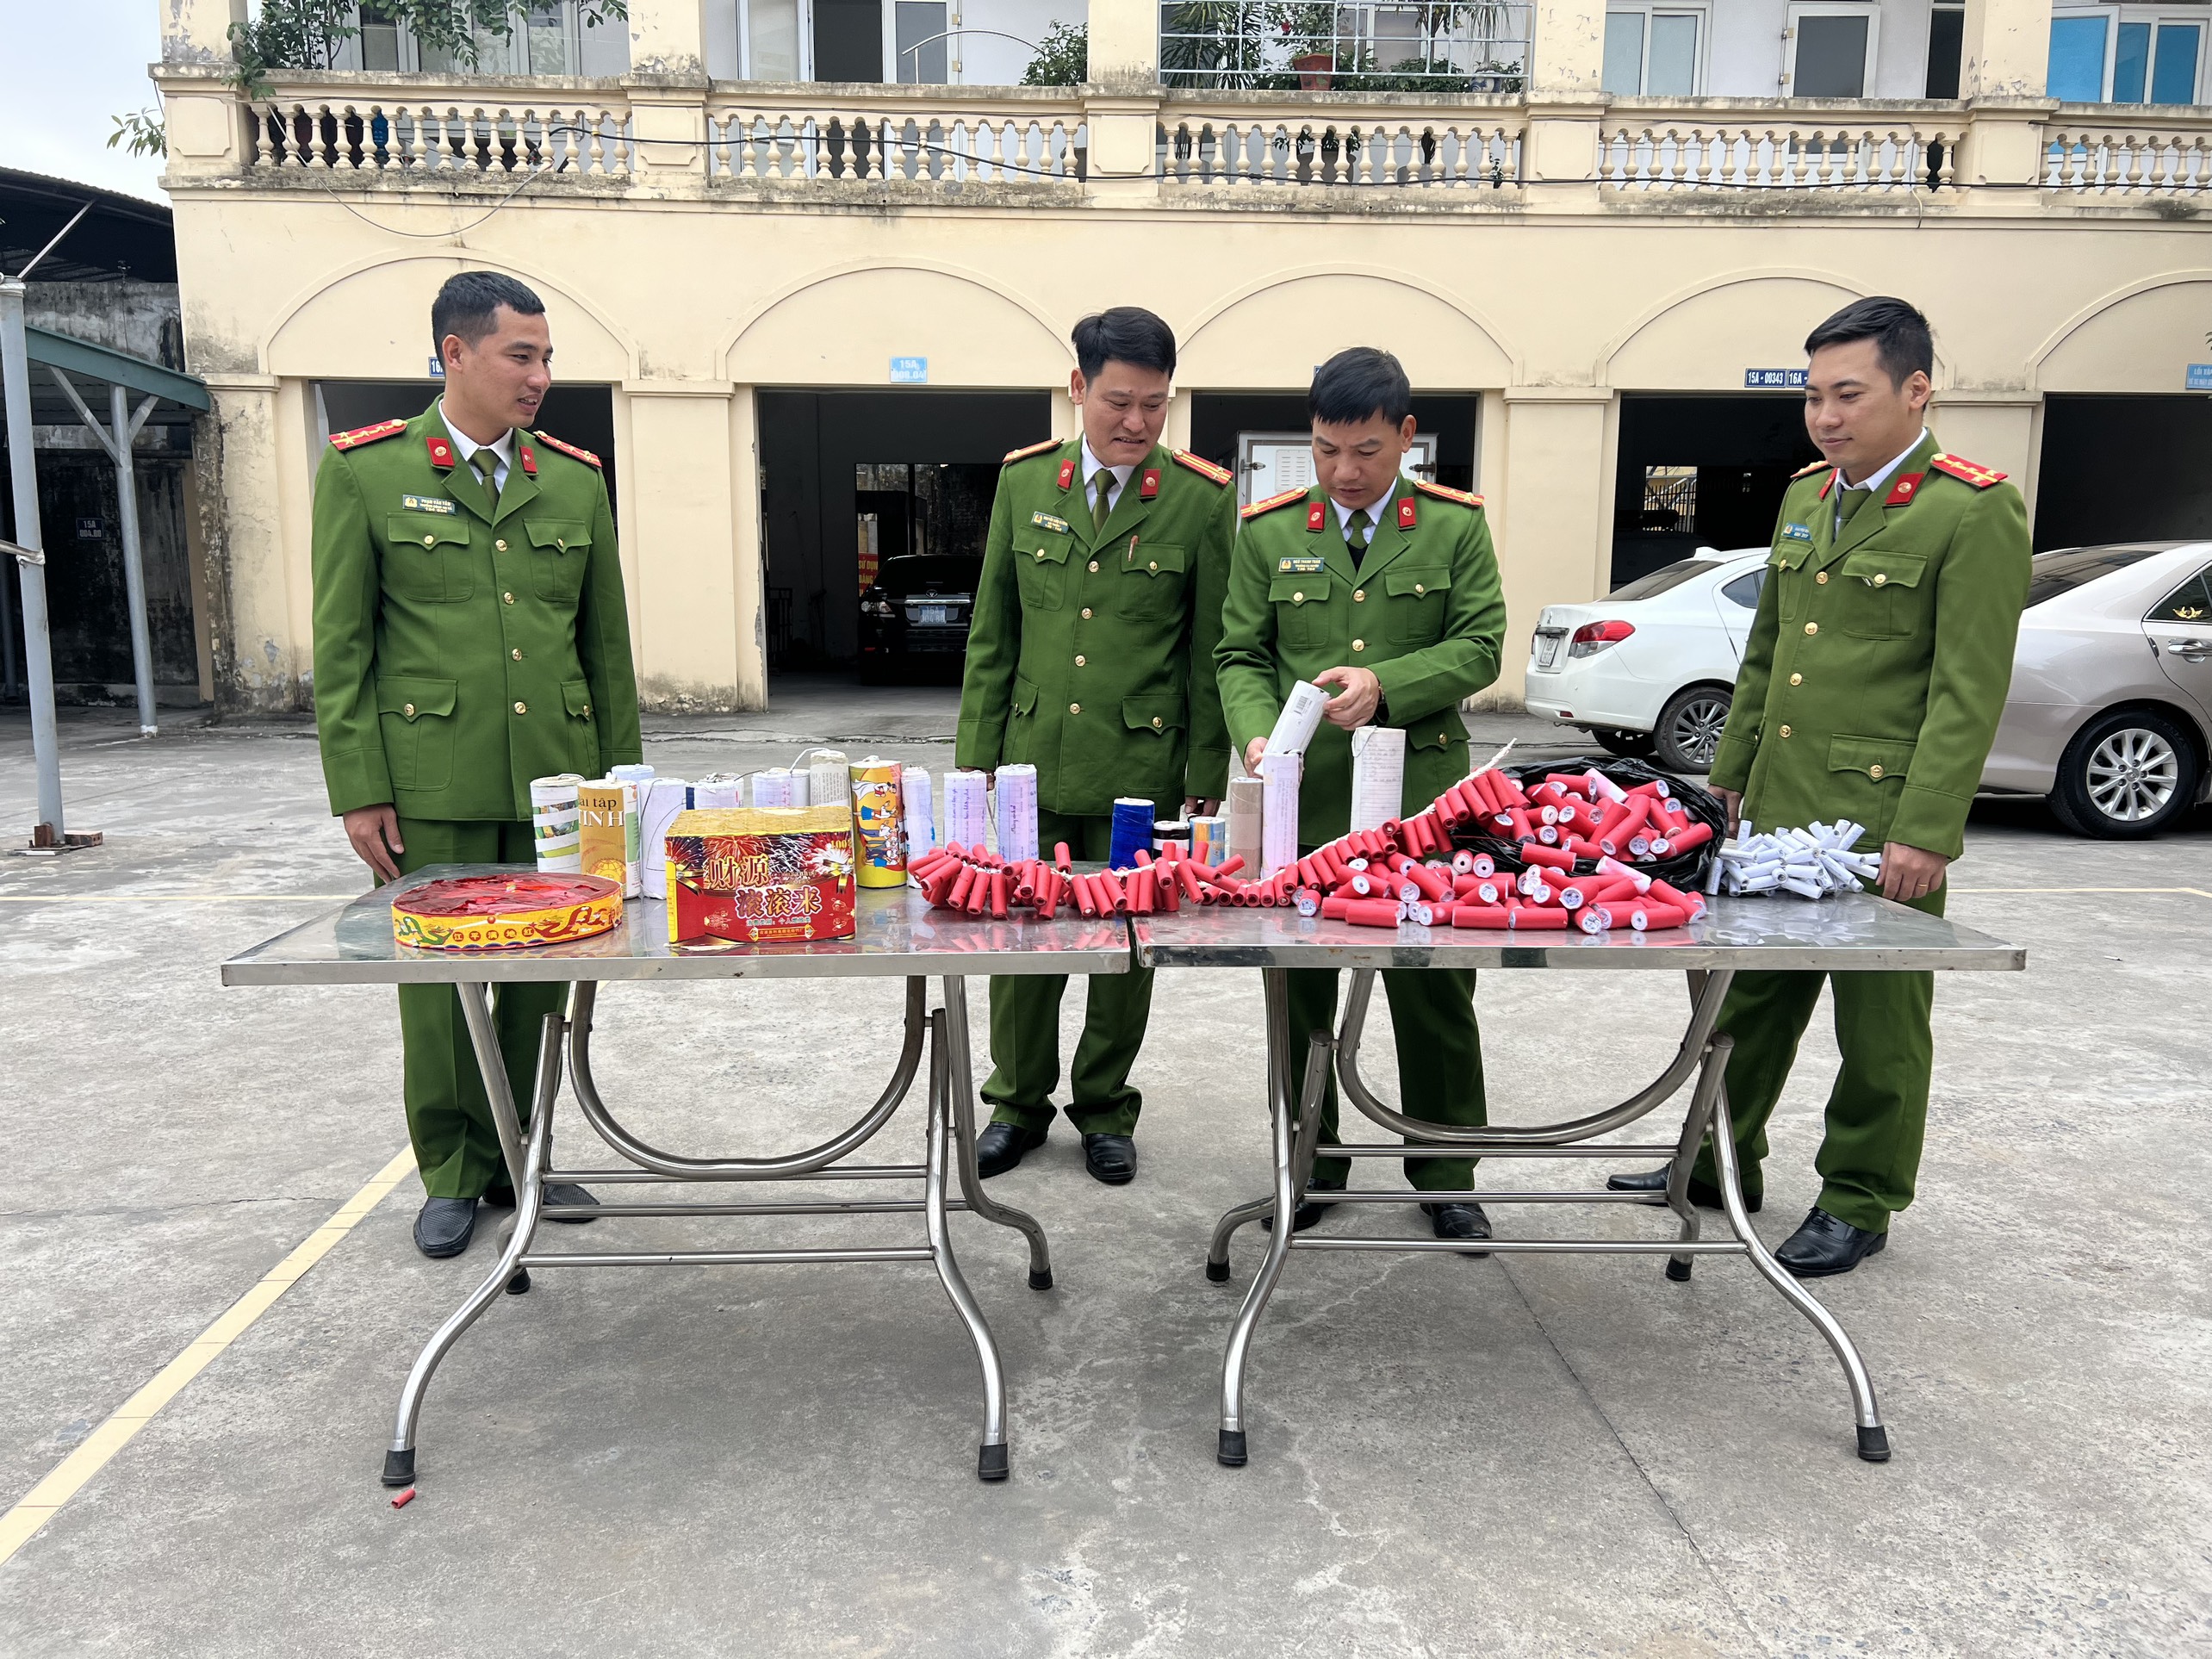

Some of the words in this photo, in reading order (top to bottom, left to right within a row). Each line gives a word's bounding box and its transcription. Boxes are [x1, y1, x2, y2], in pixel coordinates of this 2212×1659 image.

[432, 360, 443, 372] 16
[899, 360, 917, 369] 15A
[1748, 372, 1759, 383] 15A
[1764, 372, 1783, 384] 00343
[1789, 372, 1802, 384] 16A
[926, 606, 939, 614] 15A
[709, 854, 770, 890] 财源
[736, 885, 821, 918] 滚滚来
